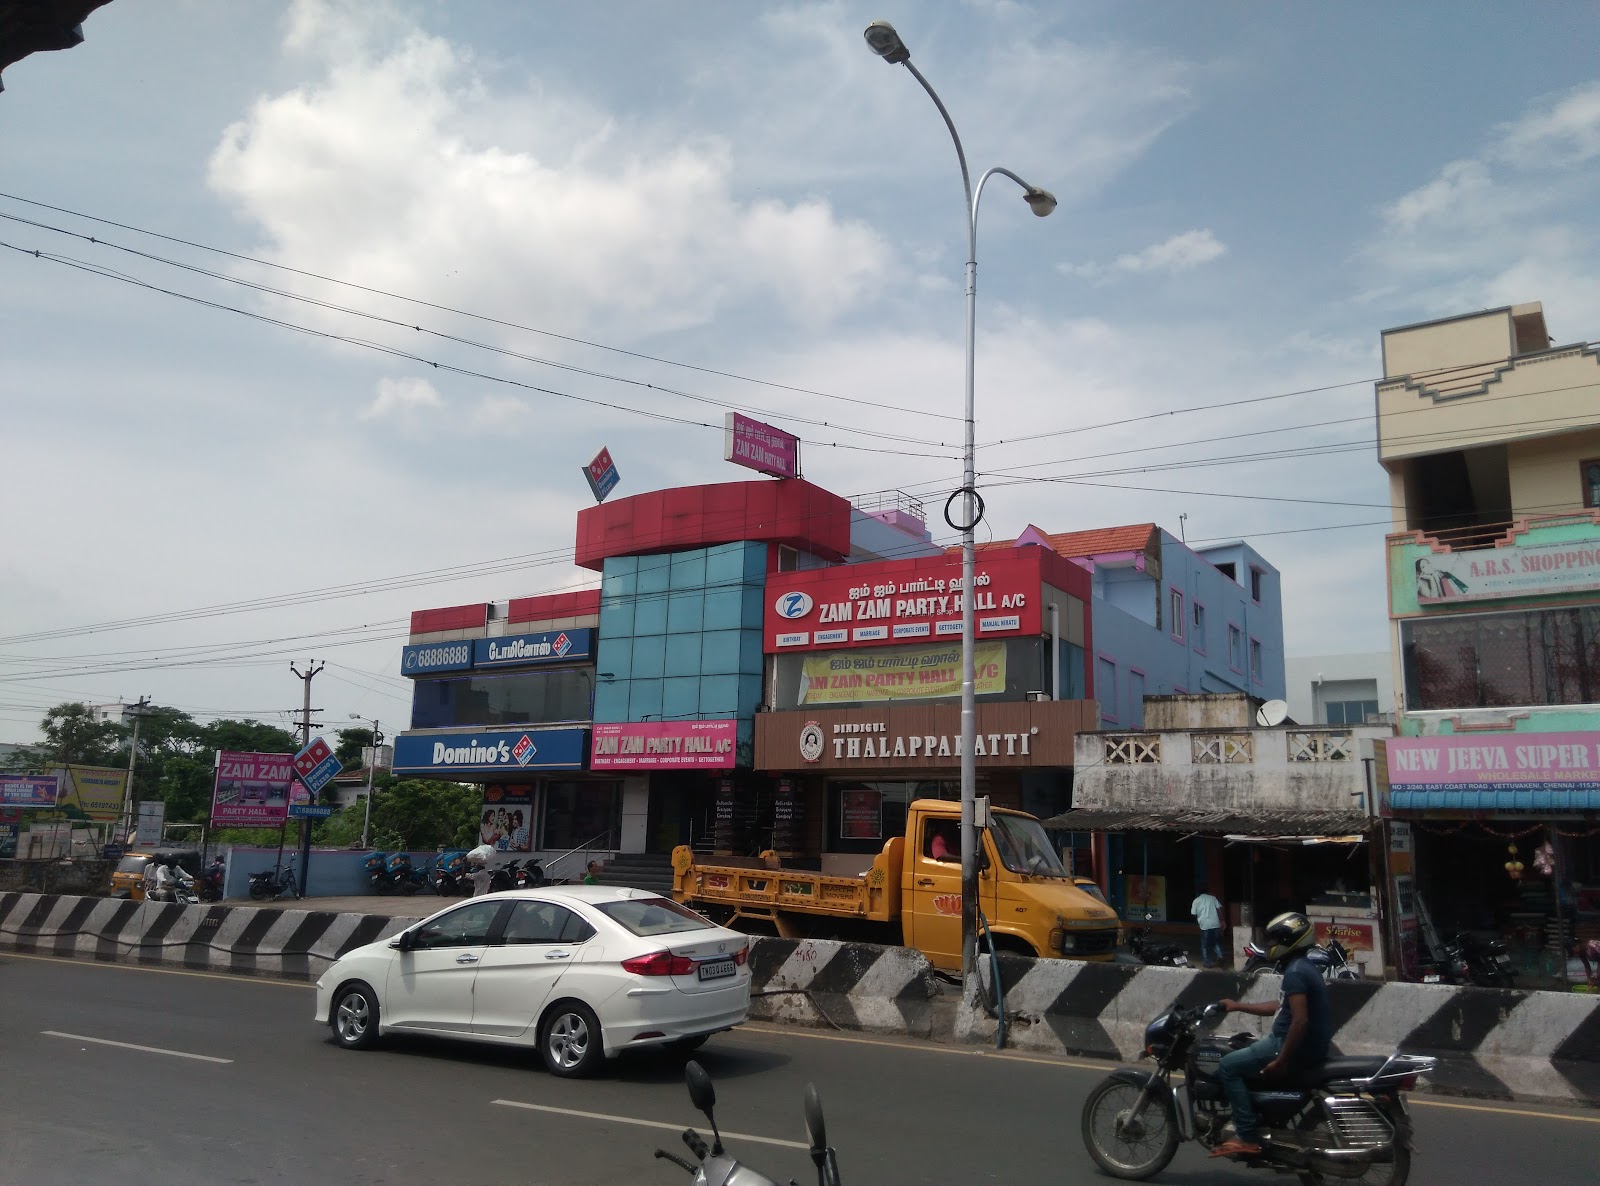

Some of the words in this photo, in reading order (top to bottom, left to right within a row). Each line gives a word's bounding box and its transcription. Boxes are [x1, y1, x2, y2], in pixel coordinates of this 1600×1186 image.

[1470, 558, 1516, 578] A.R.S.
[849, 583, 870, 600] ஜம்
[874, 580, 896, 598] ஜம்
[820, 601, 852, 623] ZAM
[856, 598, 891, 620] ZAM
[896, 596, 950, 616] PARTY
[1002, 594, 1026, 608] A/C
[818, 633, 844, 641] ENGAGEMENT
[418, 646, 468, 667] 68886888
[832, 674, 862, 688] ZAM
[866, 671, 914, 687] PARTY
[918, 668, 956, 686] HALL
[834, 723, 886, 734] DINDIGUL
[432, 740, 510, 764] Domino's
[595, 737, 618, 754] ZAM
[621, 736, 644, 754] ZAM
[646, 736, 682, 754] PARTY
[685, 736, 712, 753] HALL
[715, 738, 732, 754] A/C
[1395, 749, 1440, 771] NEW
[1448, 746, 1509, 774] JEEVA
[1516, 744, 1590, 769] SUPER
[220, 763, 254, 778] ZAM
[258, 764, 292, 780] ZAM
[307, 758, 335, 783] Domino's
[1478, 770, 1550, 781] WHOLESALE
[312, 773, 330, 790] Pizza
[826, 892, 854, 900] MOVERS
